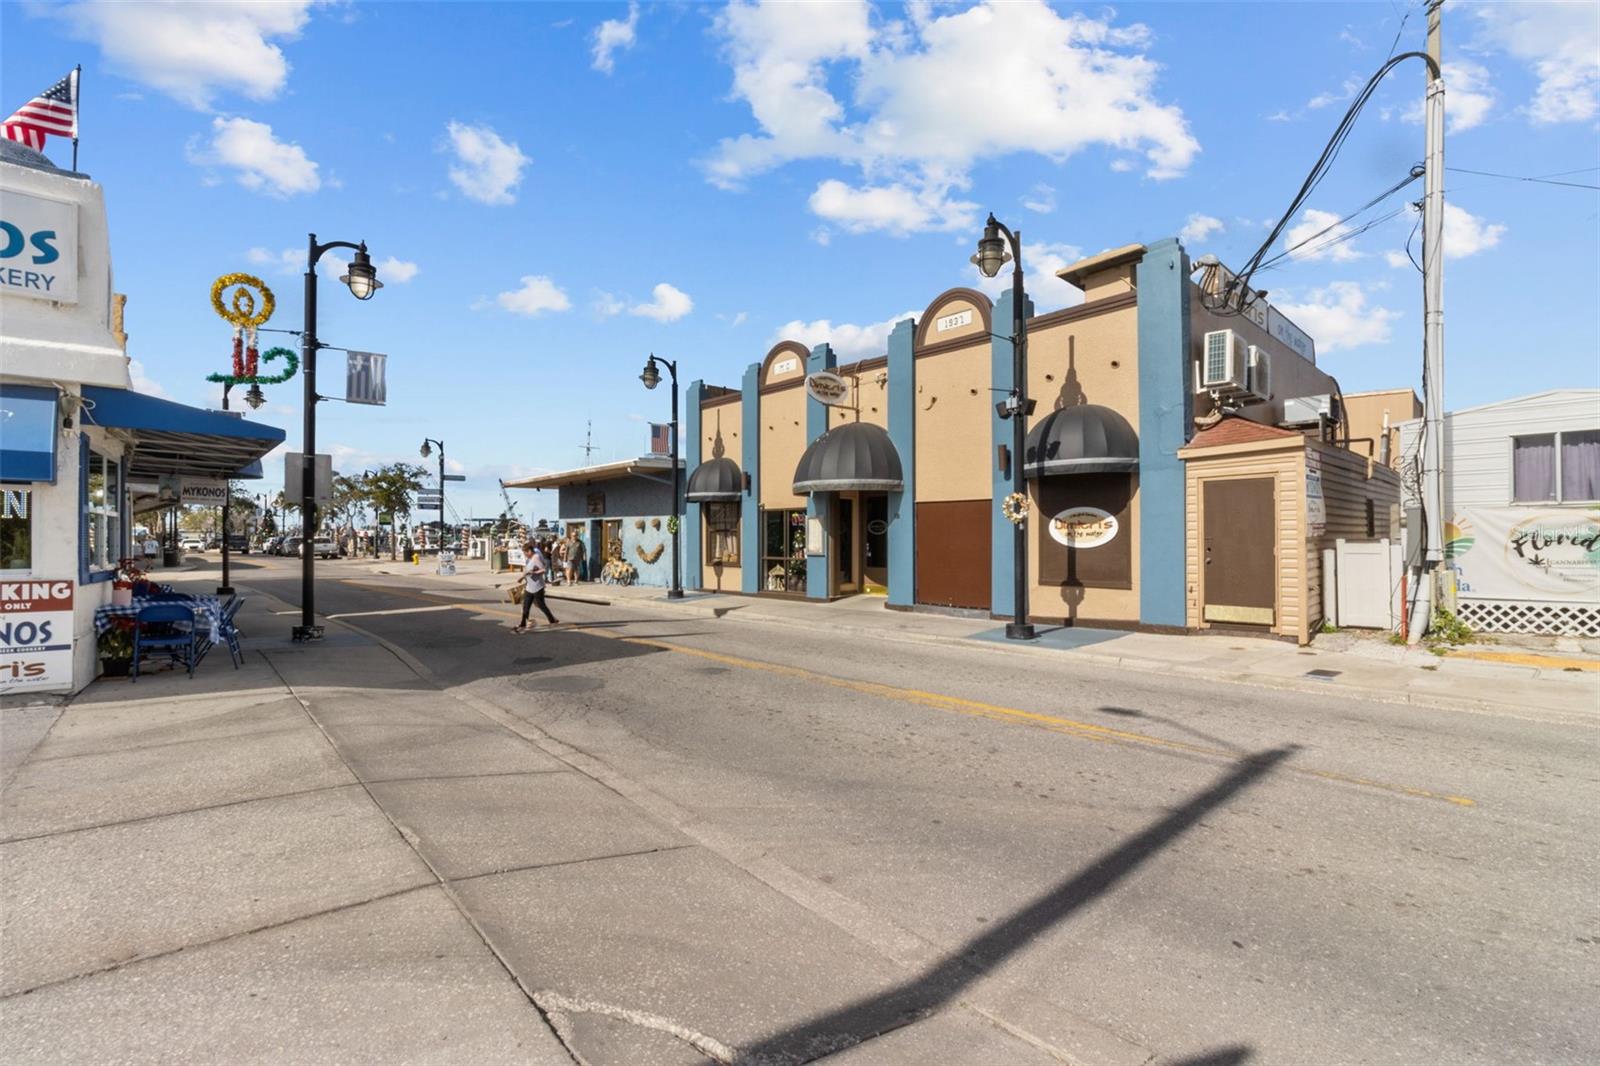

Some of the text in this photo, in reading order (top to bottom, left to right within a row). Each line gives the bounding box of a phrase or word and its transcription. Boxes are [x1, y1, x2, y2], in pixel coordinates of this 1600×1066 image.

[182, 486, 226, 498] MYKONOS
[1, 582, 71, 601] KING
[4, 602, 32, 610] ONLY
